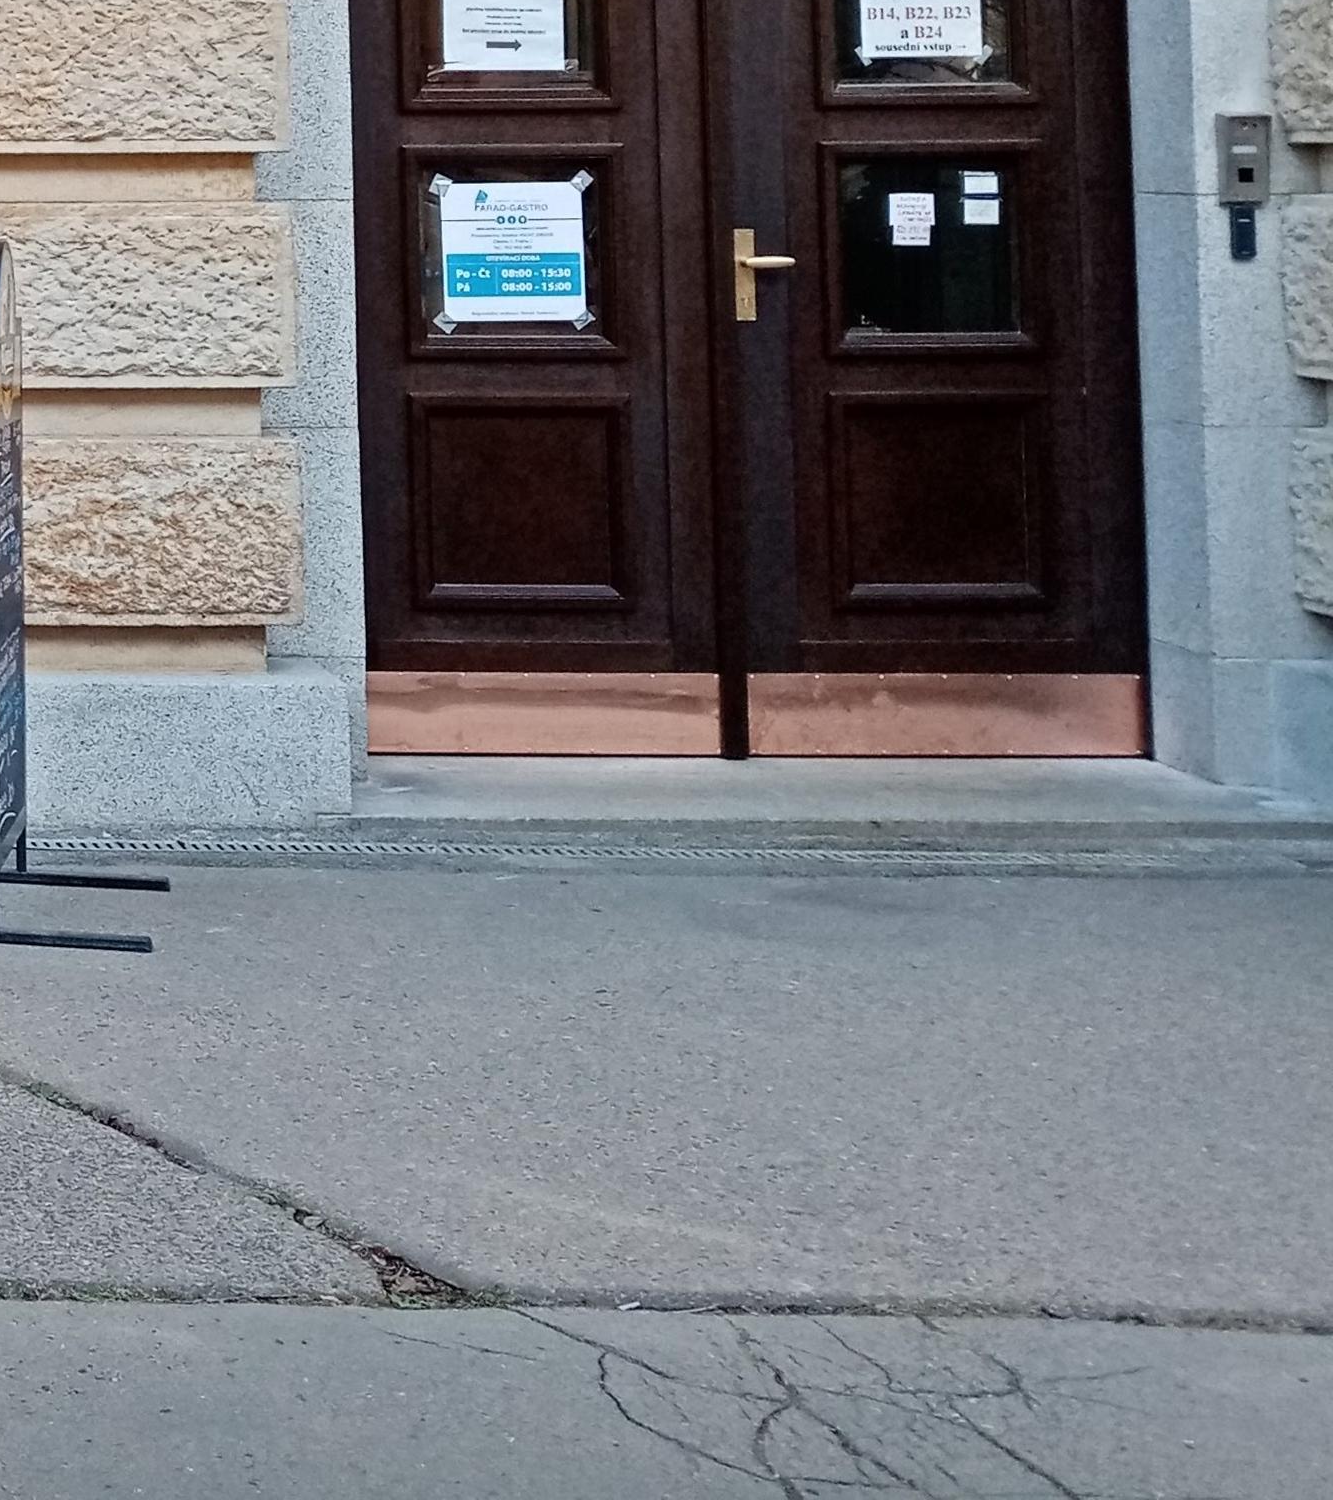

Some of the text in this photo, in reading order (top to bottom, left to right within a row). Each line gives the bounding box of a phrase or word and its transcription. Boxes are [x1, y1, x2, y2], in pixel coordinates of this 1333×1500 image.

[867, 6, 971, 20] B14, B22, B23
[900, 26, 942, 39] a B24
[923, 43, 952, 52] vstup
[456, 269, 470, 278] Po
[501, 268, 532, 278] 08:00
[541, 268, 571, 278] 15:30
[501, 282, 533, 292] 08:00
[541, 282, 572, 292] 15:00
